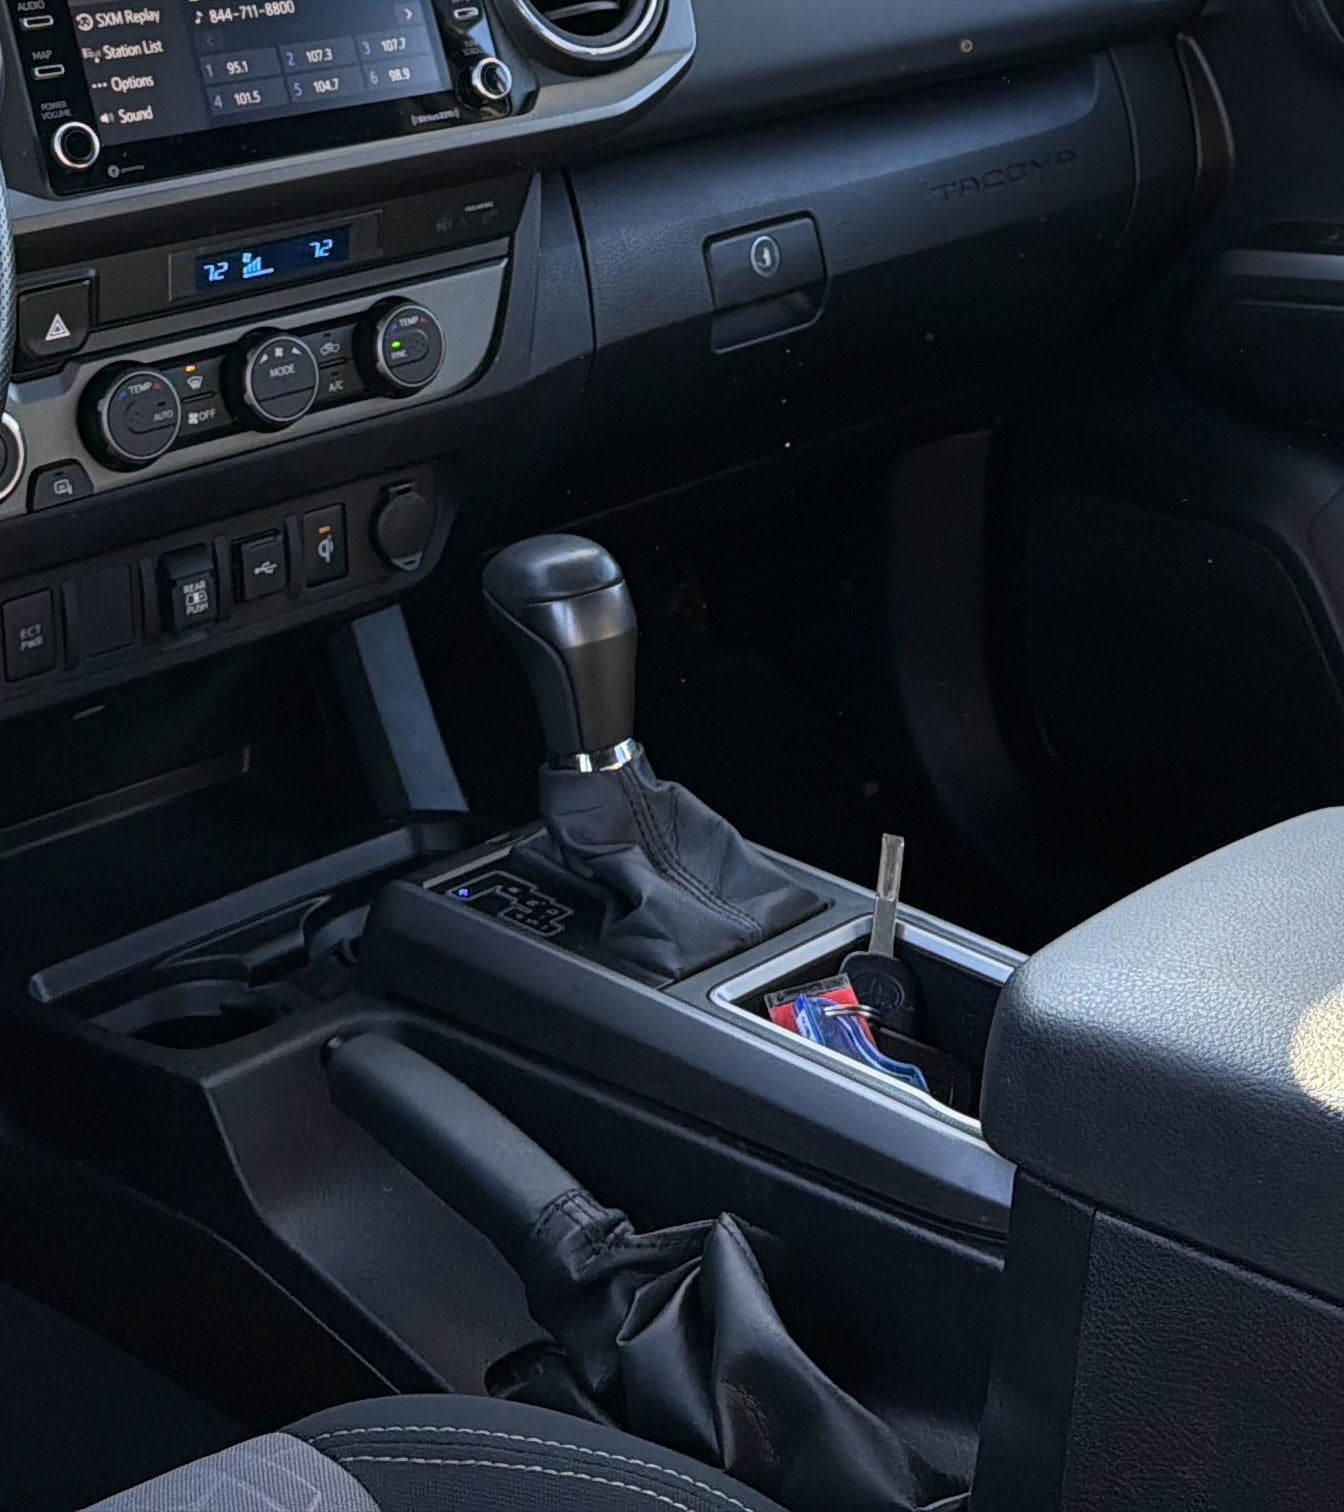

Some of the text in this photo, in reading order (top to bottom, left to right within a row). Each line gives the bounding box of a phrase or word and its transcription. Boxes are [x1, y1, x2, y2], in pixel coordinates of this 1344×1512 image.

[17, 0, 46, 12] AUDIO
[209, 0, 296, 24] 844-711-8800
[95, 8, 161, 28] SXM Replay
[32, 49, 53, 61] MAP
[103, 39, 164, 60] Station List
[362, 37, 407, 56] 3 107.7
[286, 48, 333, 67] 2 107.3
[205, 60, 249, 78] 1 95.1
[369, 67, 411, 85] 6 98.9
[110, 75, 155, 94] Options
[293, 78, 339, 97] 5 104.7
[213, 90, 261, 109] 4 101.5
[118, 105, 154, 124] Sound
[203, 238, 334, 282] 72 72
[399, 315, 419, 328] TEMP
[269, 363, 296, 378] MODE
[128, 381, 153, 395] TEMP
[328, 380, 344, 393] A/C
[153, 409, 174, 421] AUTO
[198, 408, 217, 421] OFF
[20, 623, 42, 640] ECT
